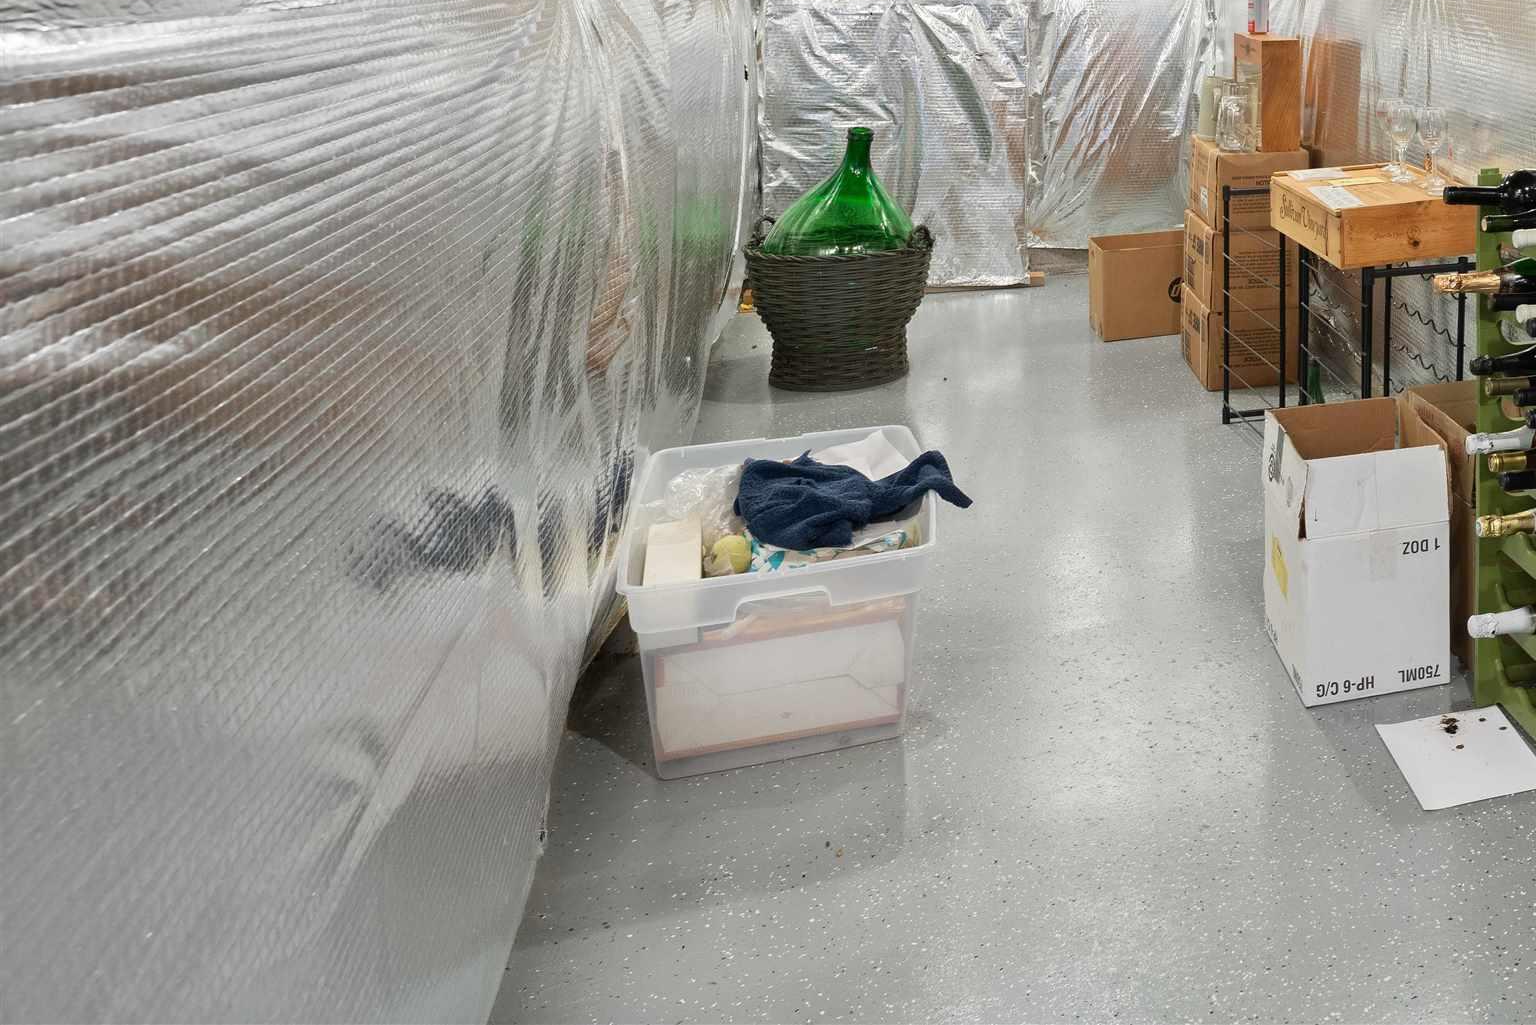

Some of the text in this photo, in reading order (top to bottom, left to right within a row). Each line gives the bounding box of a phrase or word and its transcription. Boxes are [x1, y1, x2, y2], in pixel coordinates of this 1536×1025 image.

[1402, 537, 1441, 555] 1 DOZ
[1316, 664, 1441, 698] 750ML HP-6 C/G
